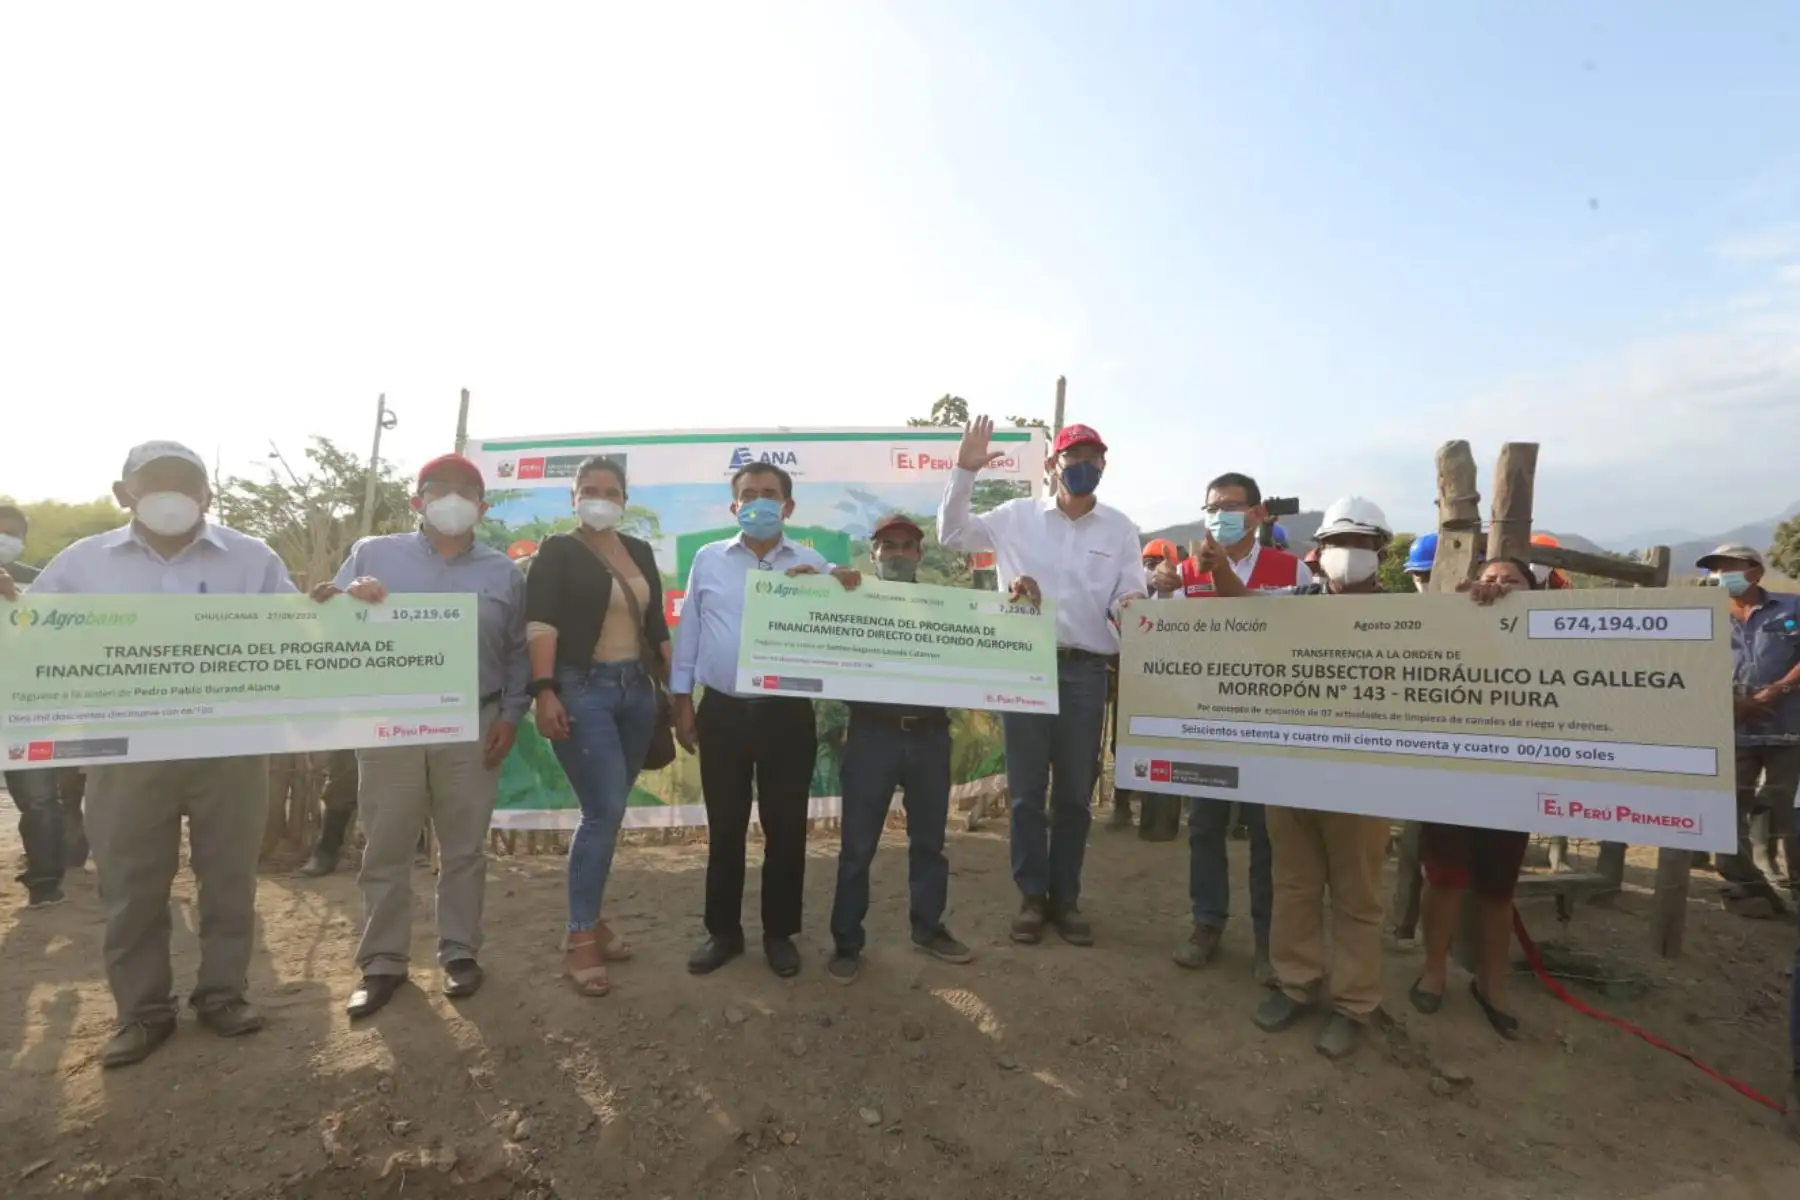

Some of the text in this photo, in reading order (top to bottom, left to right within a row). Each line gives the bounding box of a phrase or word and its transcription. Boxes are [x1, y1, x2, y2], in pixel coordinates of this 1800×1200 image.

[760, 451, 797, 465] ANA
[896, 454, 915, 469] EL
[42, 609, 138, 630] Agrobanco
[391, 609, 461, 621] 10,219.66
[809, 611, 996, 637] TRANSFERENCIA DEL PROGRAMA DE
[1155, 617, 1268, 633] Banco de la Nación
[1499, 615, 1669, 634] S/ 674,194.00
[768, 621, 865, 638] FINANCIAMIENTO
[867, 629, 912, 642] DIRECTO
[914, 633, 933, 644] DEL
[936, 635, 974, 647] FONDO
[1353, 619, 1422, 633] Agosto 2020
[103, 640, 395, 658] TRANSFERENCIA DEL PROGRAMA DE
[1291, 648, 1462, 661] TRANSFERENCIA A LA ORDEN DE
[35, 654, 445, 678] FINANCIAMIENTO DIRECTO DEL FONDO AGROPERÚ
[1143, 659, 1686, 689] NÚCLEO EJECUTOR SUBSECTOR HIDRÁULICO LA GALLEGA
[134, 686, 168, 696] Pedro
[171, 685, 201, 695] Pablo
[1218, 678, 1321, 700] MORROPÓN
[1352, 685, 1386, 702] 143
[1404, 684, 1483, 706] REGIÓN
[1490, 689, 1560, 708] PIURA
[1197, 703, 1210, 712] Por
[1211, 704, 1249, 715] concepto
[1250, 706, 1261, 715] de
[1307, 708, 1319, 717] de
[1321, 708, 1333, 717] 07
[1335, 709, 1388, 720] actividades
[1389, 711, 1401, 721] de
[1405, 712, 1447, 725] limpieza
[1449, 714, 1463, 724] de
[1465, 715, 1506, 727] canales
[1508, 717, 1523, 728] de
[1526, 719, 1555, 730] riego
[1557, 721, 1565, 731] y
[1181, 723, 1615, 762] Seiscientos setenta y cuatro mil ciento noventa y cuatro 00/100 soles
[1543, 799, 1694, 830] EL PERÚ PRIMERO
